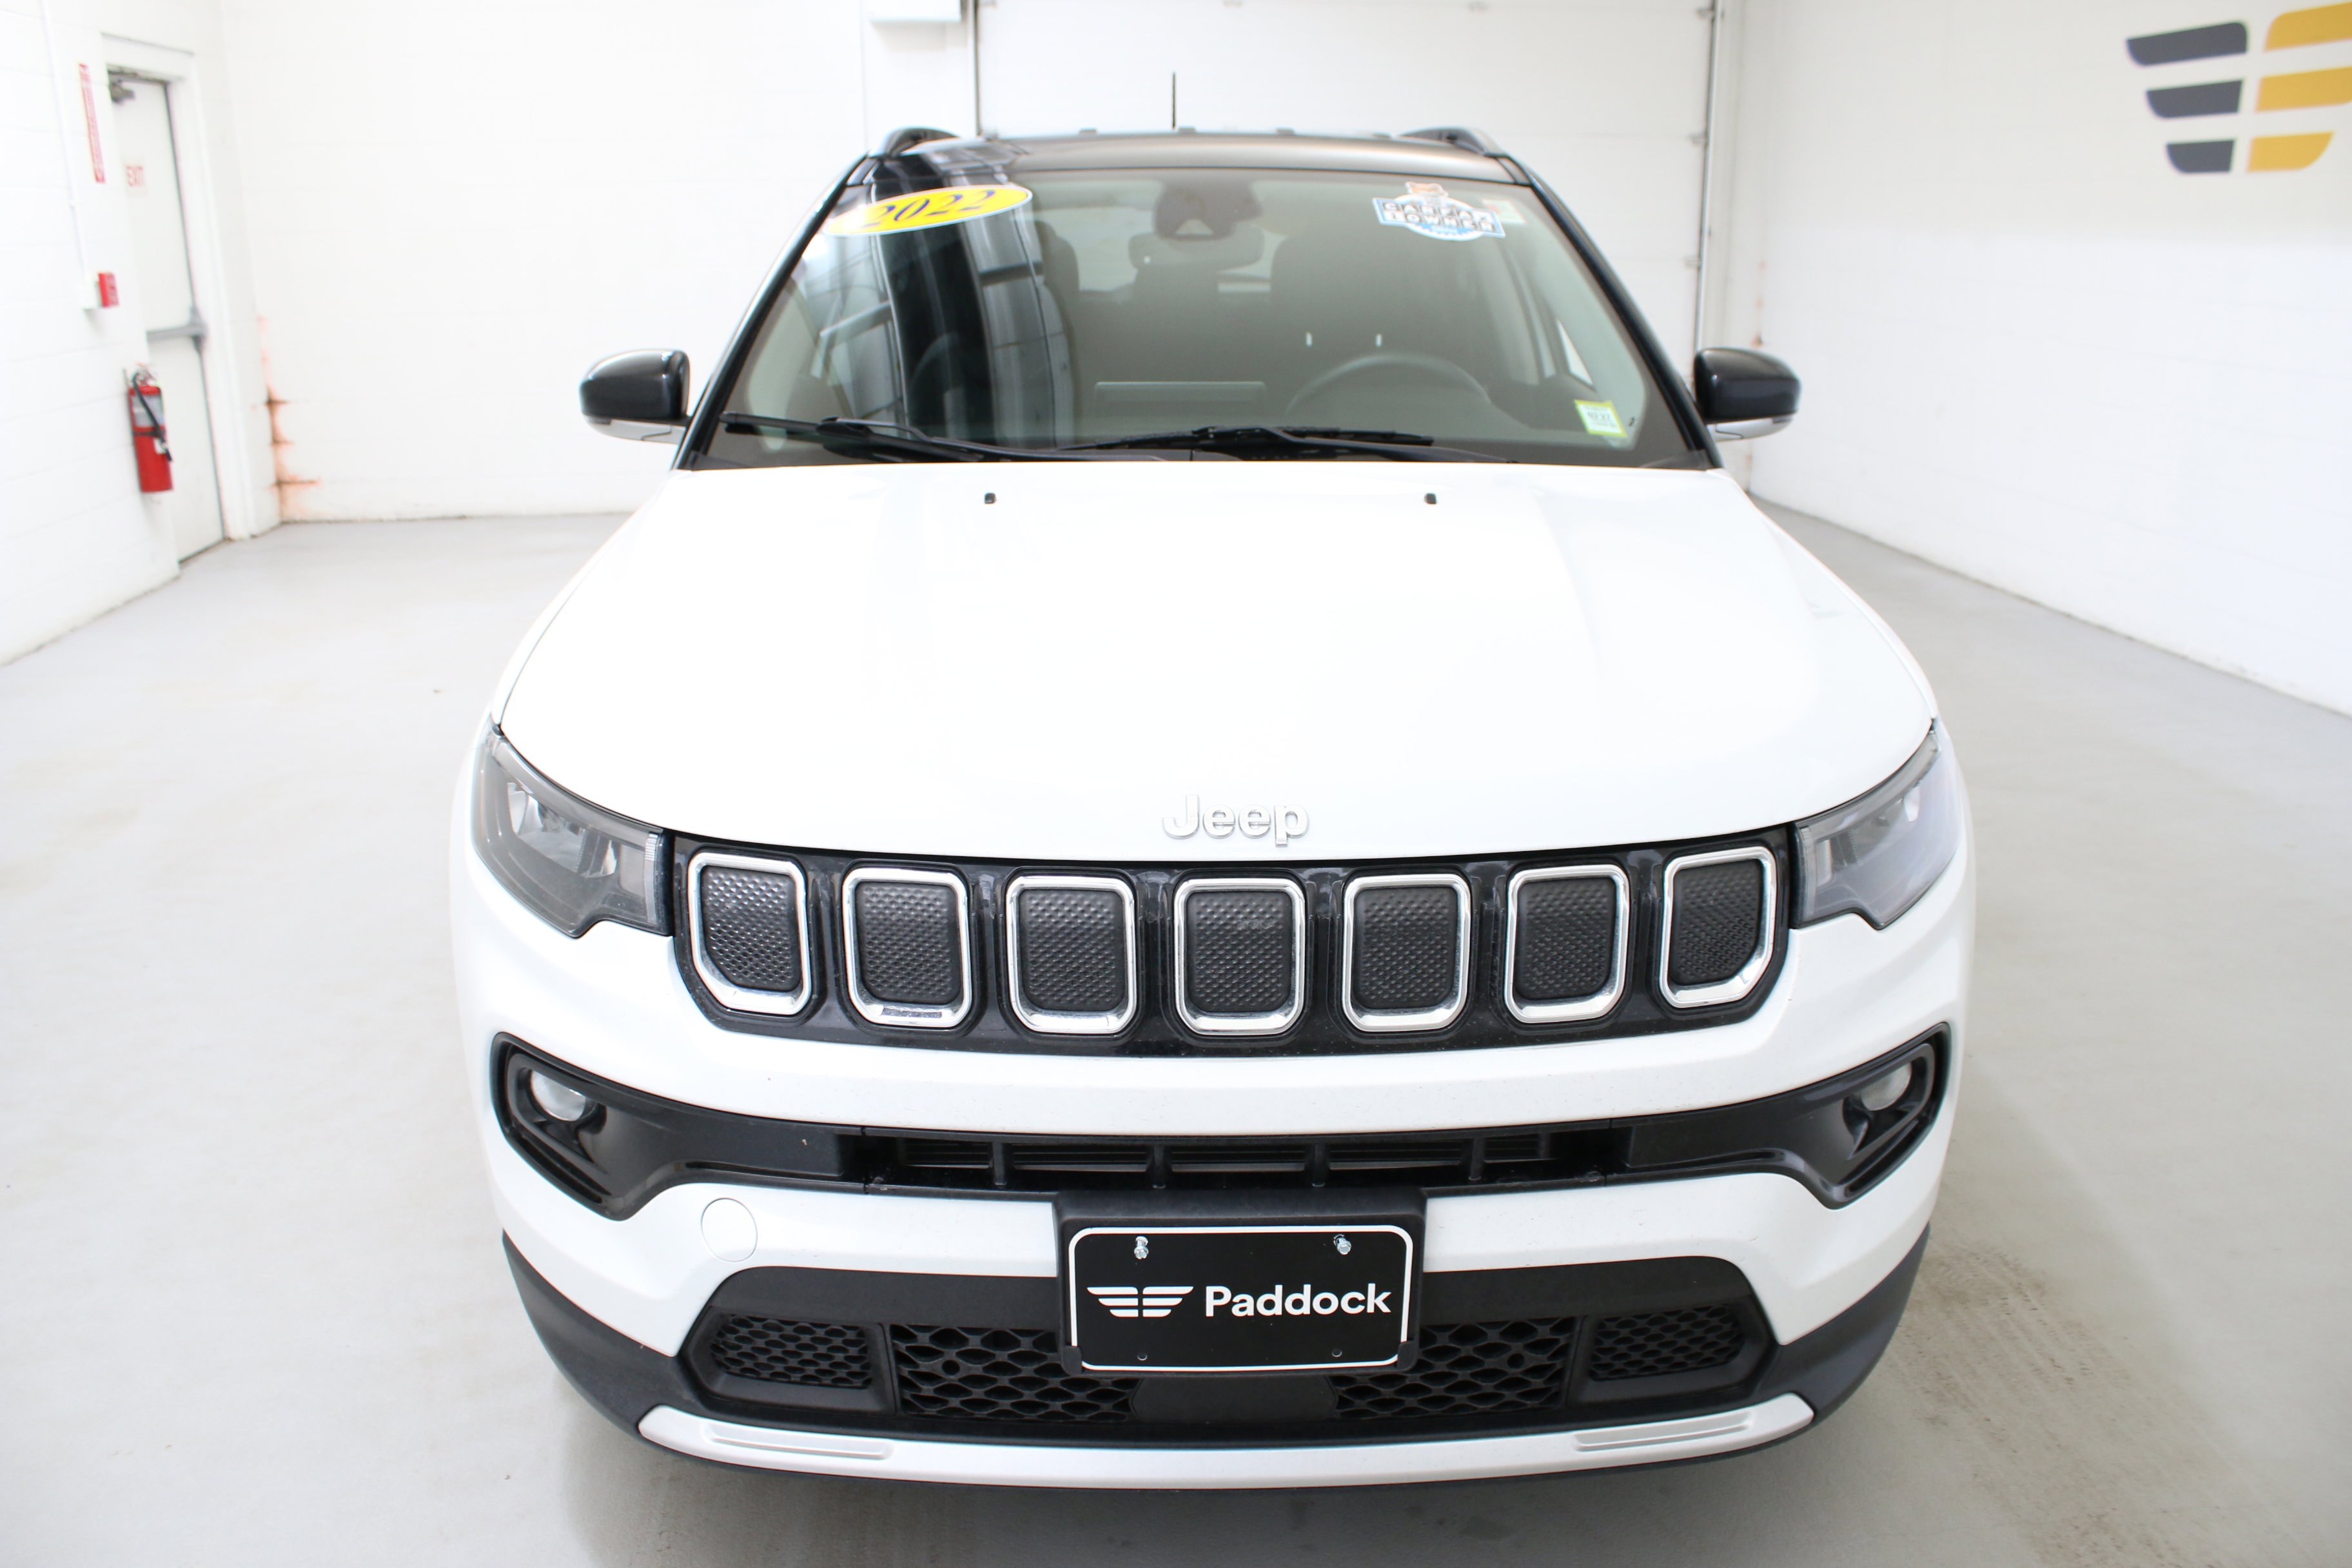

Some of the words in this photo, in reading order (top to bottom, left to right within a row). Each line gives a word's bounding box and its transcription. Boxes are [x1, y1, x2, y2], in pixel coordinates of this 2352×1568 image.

[861, 190, 996, 227] 2022
[1162, 794, 1309, 847] Jeep
[1206, 1283, 1391, 1317] Paddock
